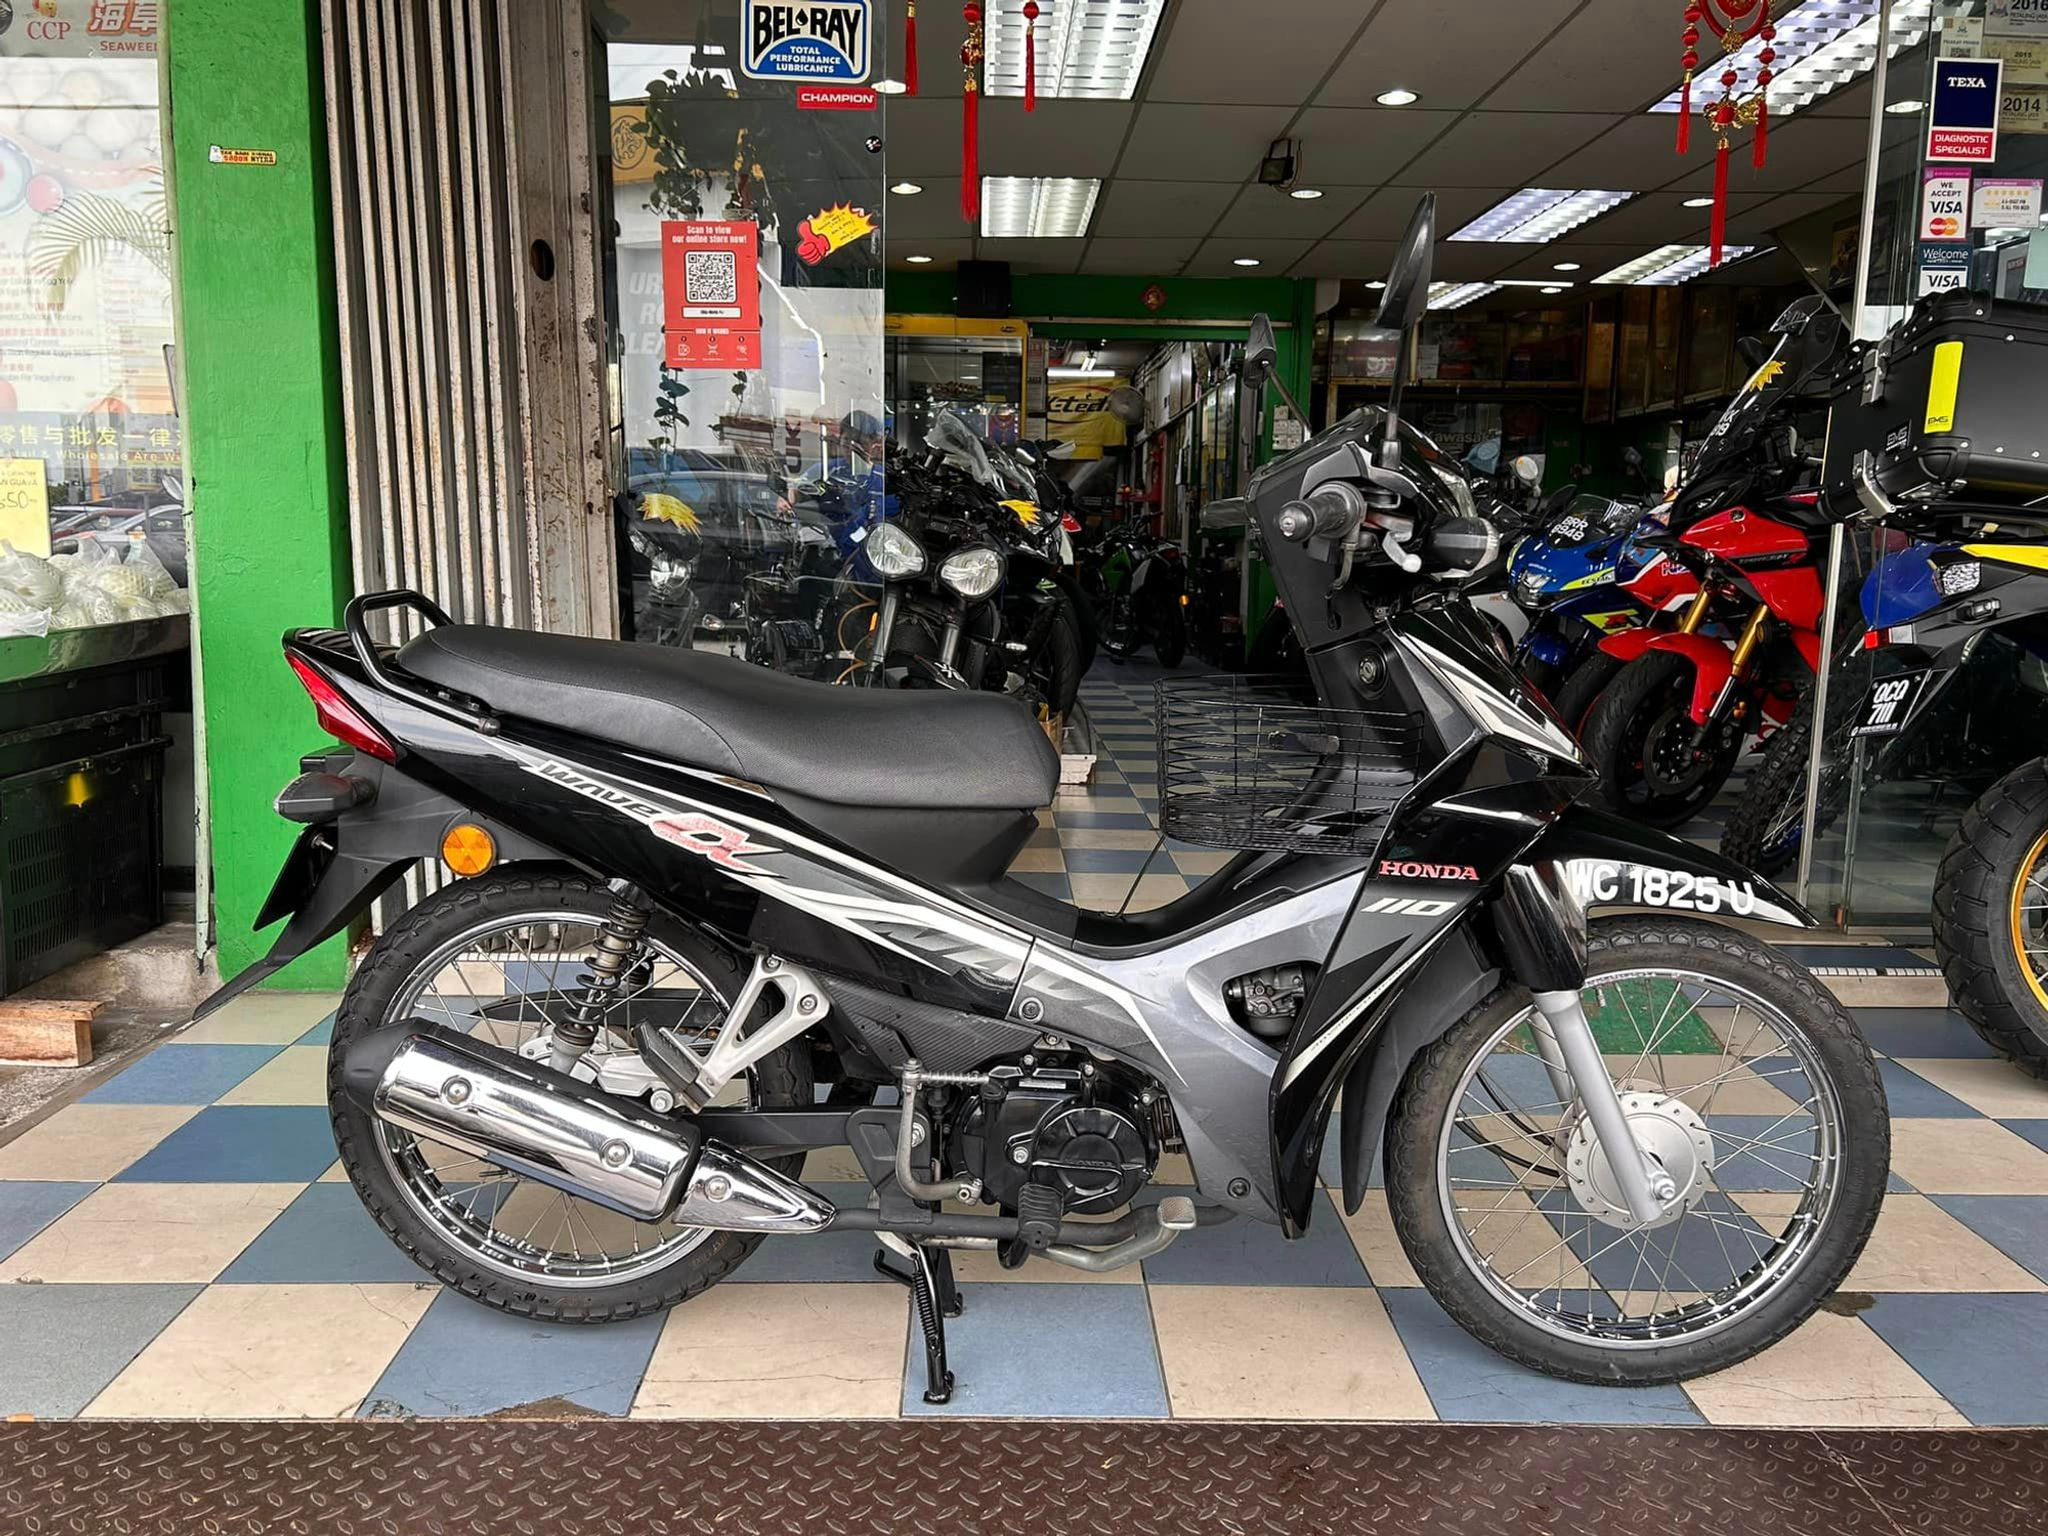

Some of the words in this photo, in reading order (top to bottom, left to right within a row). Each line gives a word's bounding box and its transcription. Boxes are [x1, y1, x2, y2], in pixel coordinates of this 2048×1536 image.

[28, 21, 71, 40] CCP
[790, 46, 820, 55] TOTAL
[770, 54, 841, 64] PERFORMANCE
[776, 62, 834, 73] LUBRICANTS
[1947, 76, 1987, 88] TEXA
[801, 93, 874, 103] CHAMPION
[2002, 97, 2041, 112] 2014
[1935, 134, 1989, 144] DIAGNOSTIC
[1935, 145, 1987, 155] SPECIALIST
[1930, 201, 1963, 214] VISA
[687, 225, 704, 234] Scan
[705, 226, 713, 234] to
[715, 225, 731, 234] view
[686, 235, 707, 243] online
[709, 235, 728, 243] store
[730, 235, 747, 244] now!
[1923, 248, 1968, 260] Welcome
[1928, 275, 1960, 287] VISA
[57, 450, 128, 462] Wholesale
[134, 451, 158, 462] Are
[1562, 516, 1589, 531] BRR
[1379, 861, 1479, 881] HONDA
[1568, 863, 1619, 902] WC
[1630, 872, 1719, 914] 1825
[1730, 881, 1755, 914] U
[1361, 897, 1458, 916] 110
